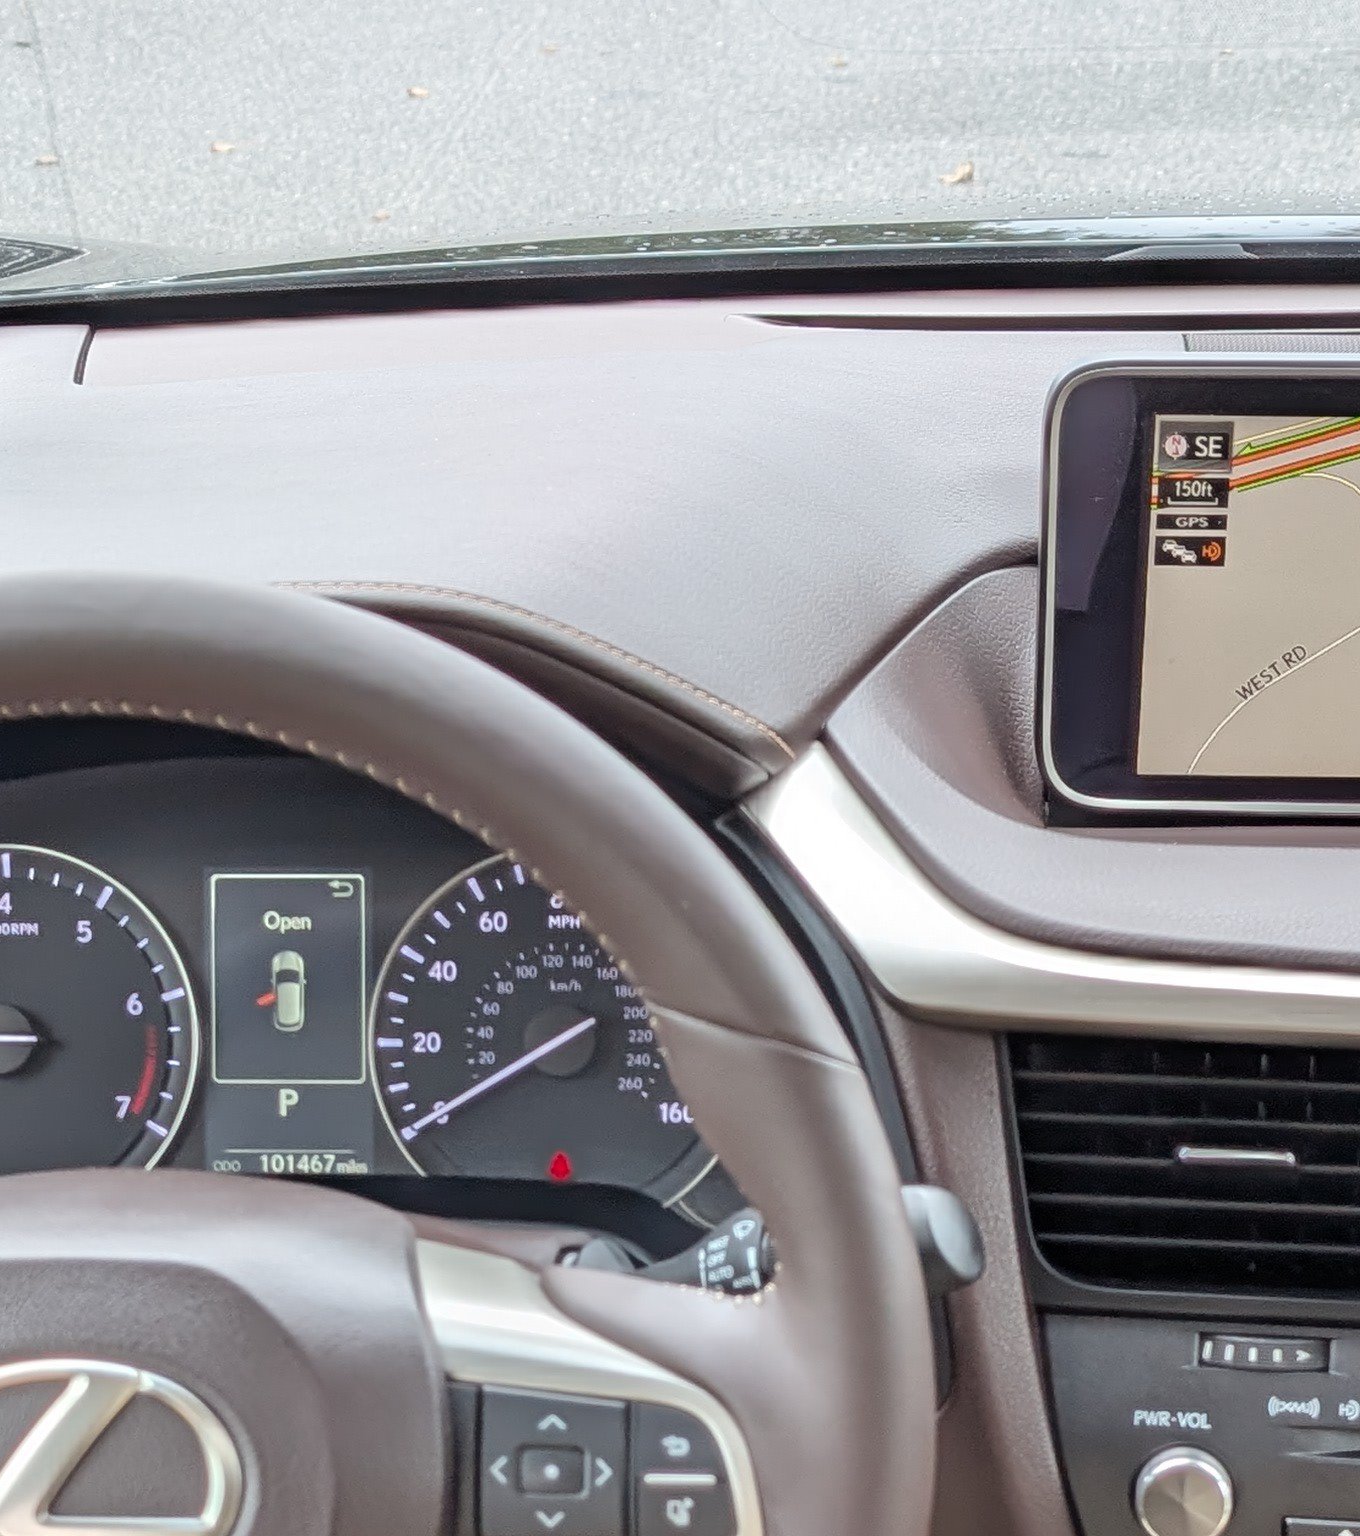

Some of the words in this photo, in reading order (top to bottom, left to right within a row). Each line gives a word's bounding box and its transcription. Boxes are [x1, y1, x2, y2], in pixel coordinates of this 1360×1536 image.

[1194, 435, 1224, 457] SE
[1175, 480, 1214, 498] 150ft
[1175, 516, 1210, 529] GPS
[1235, 660, 1283, 703] WEST
[1277, 644, 1309, 673] RD
[262, 910, 313, 933] Open
[478, 910, 508, 933] 60
[547, 914, 582, 929] MPH
[76, 920, 93, 944] 5
[542, 955, 564, 968] 120
[571, 955, 594, 969] 140
[427, 959, 458, 983] 40
[515, 965, 538, 979] 100
[596, 967, 619, 981] 160
[496, 981, 514, 995] 80
[549, 979, 582, 992] km/h
[125, 992, 144, 1017] 6
[482, 1002, 500, 1016] 60
[477, 1025, 495, 1040] 40
[628, 1029, 654, 1043] 220
[412, 1031, 442, 1054] 20
[478, 1051, 496, 1065] 20
[626, 1053, 651, 1067] 240
[617, 1077, 643, 1091] 260
[114, 1095, 132, 1119] 7
[277, 1089, 300, 1116] P
[259, 1153, 336, 1174] 101467
